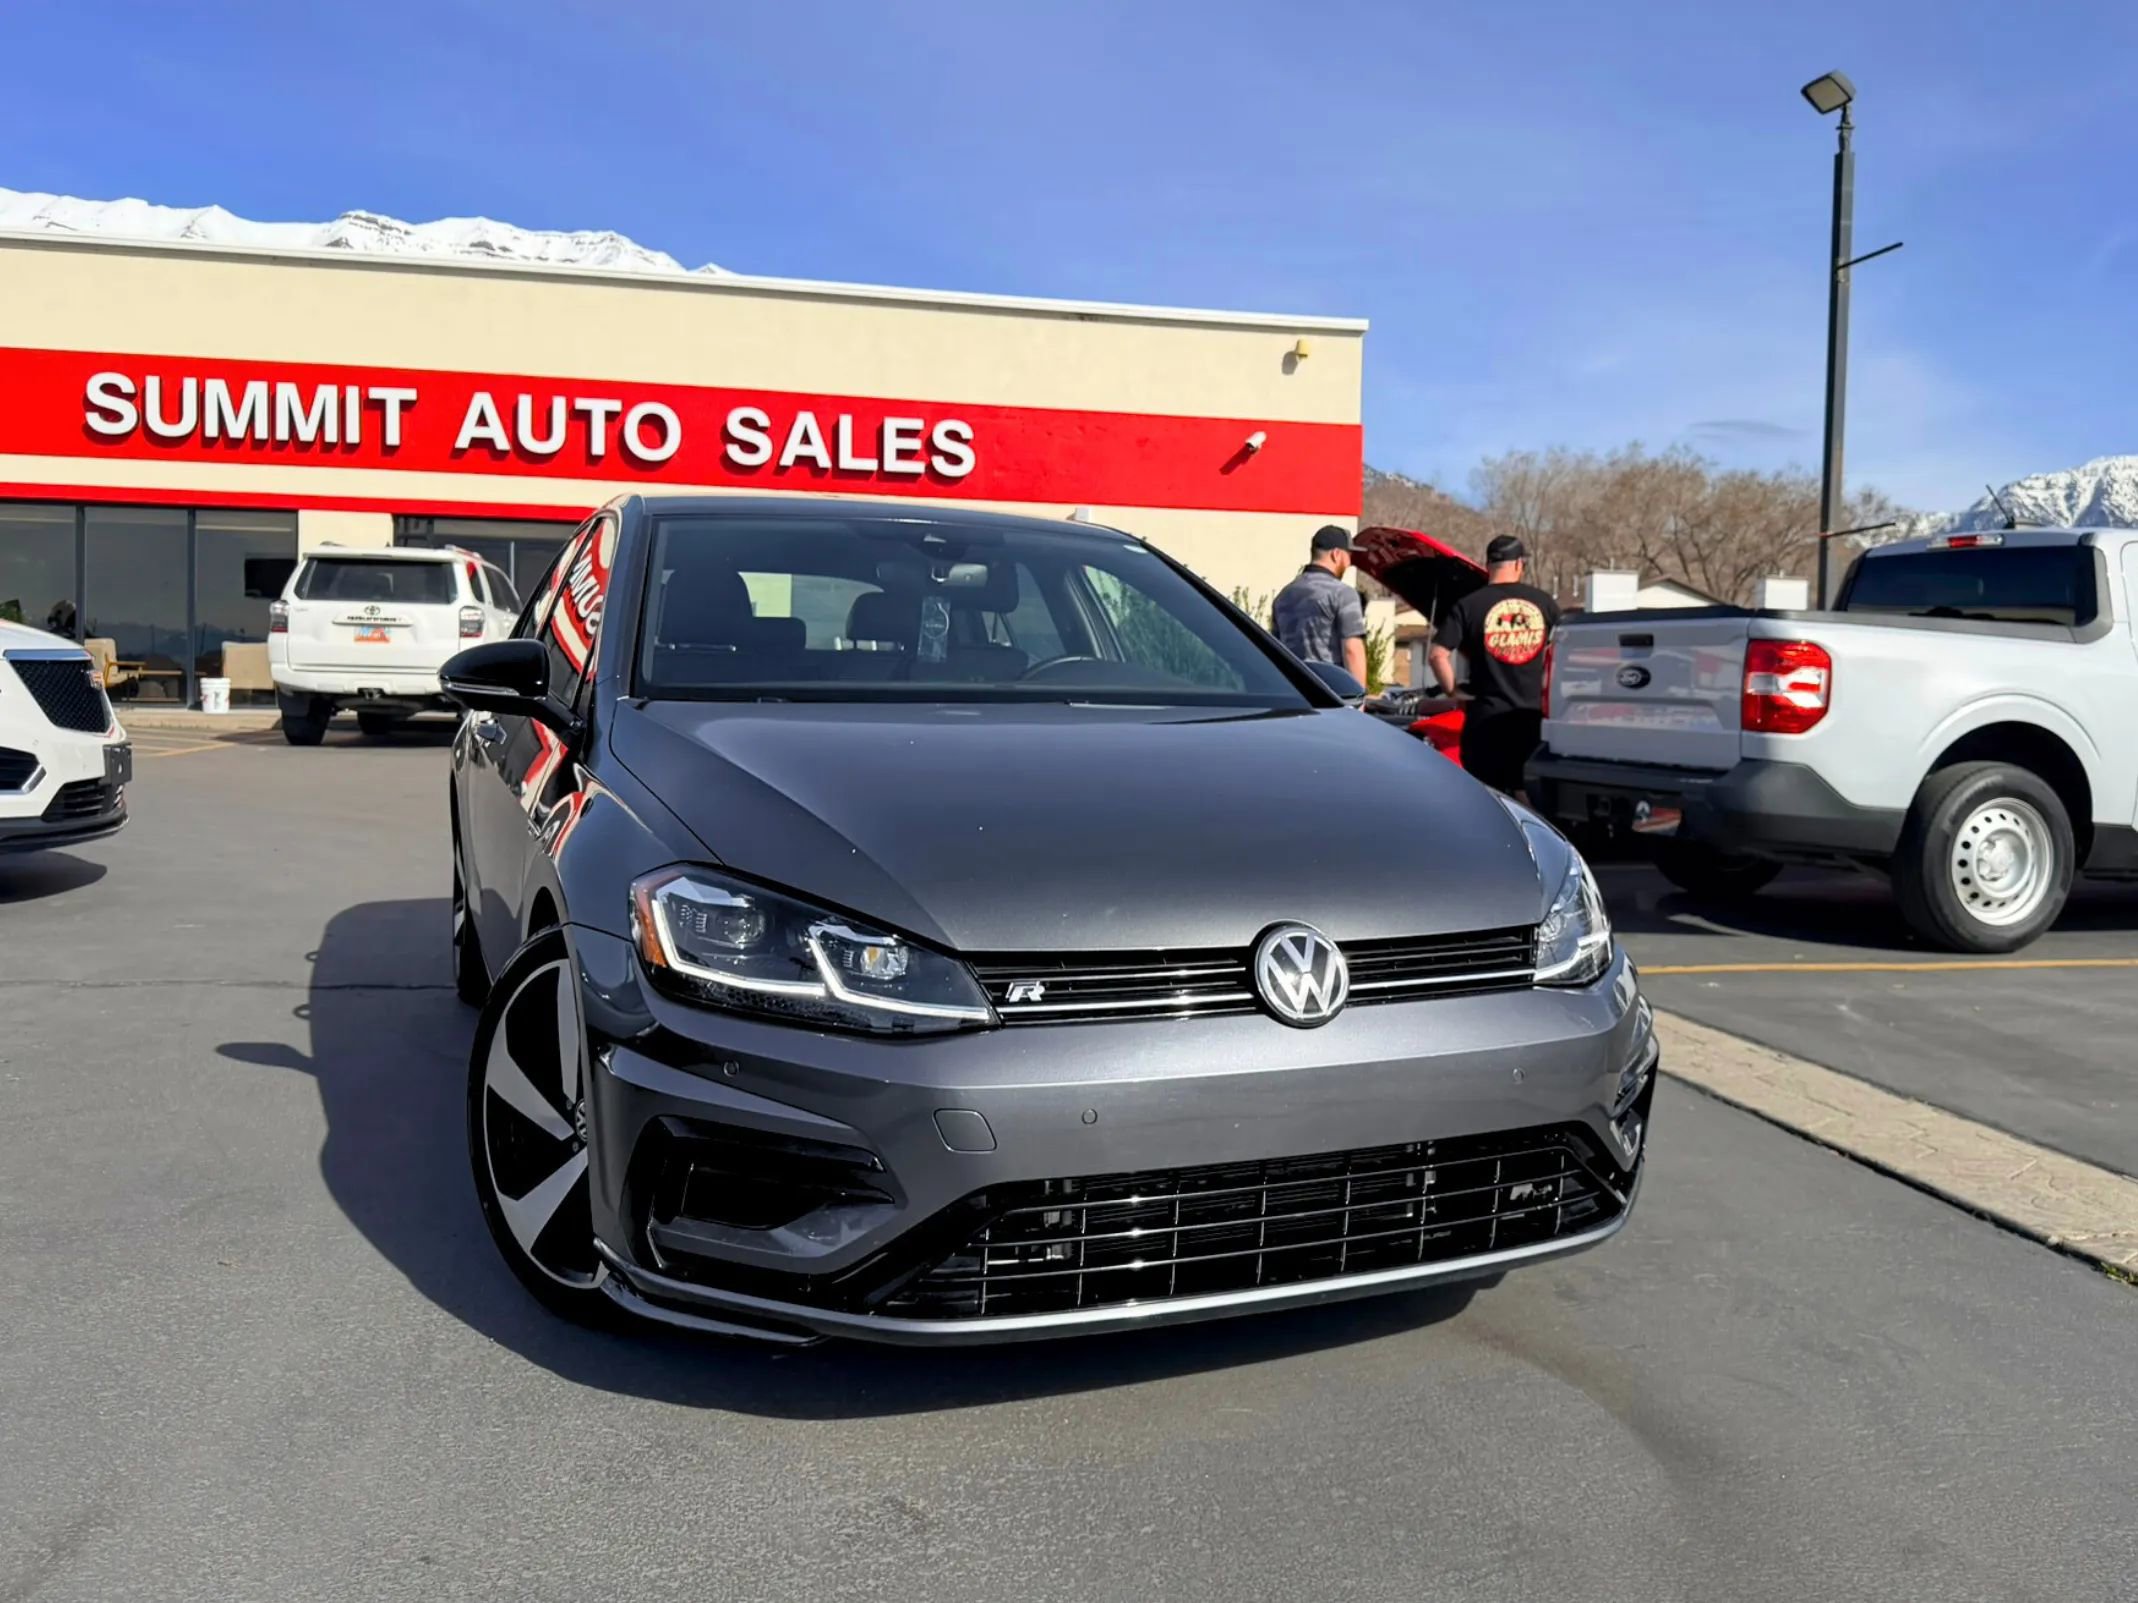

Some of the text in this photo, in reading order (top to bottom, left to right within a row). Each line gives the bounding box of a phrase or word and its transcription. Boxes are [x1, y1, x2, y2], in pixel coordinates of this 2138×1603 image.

[85, 371, 976, 478] SUMMIT AUTO SALES
[1488, 630, 1543, 648] GLAMIS
[1006, 981, 1045, 1003] R
